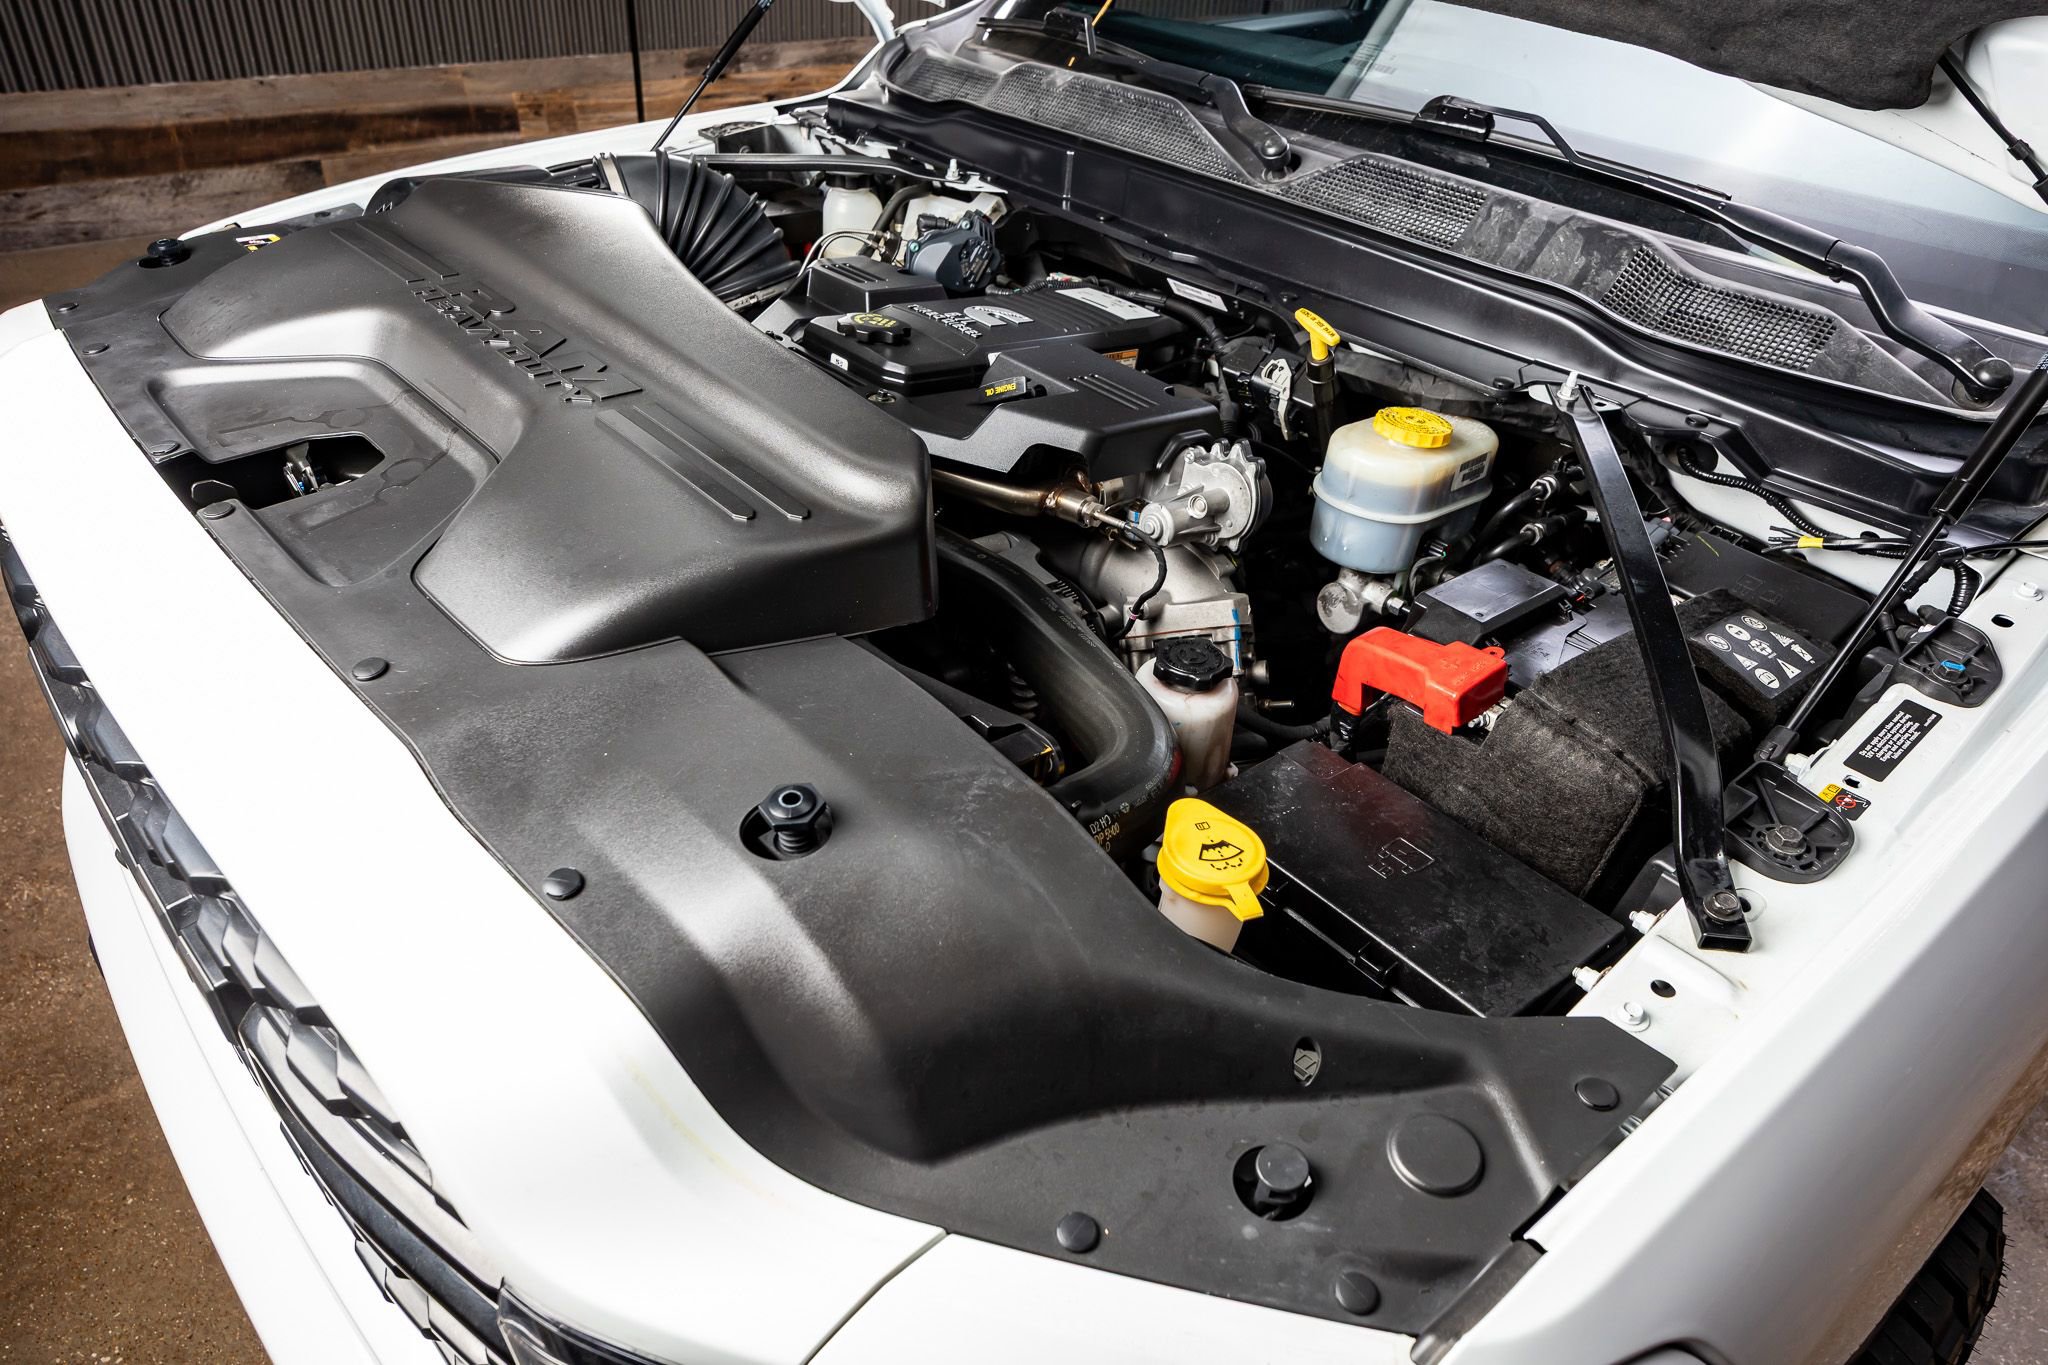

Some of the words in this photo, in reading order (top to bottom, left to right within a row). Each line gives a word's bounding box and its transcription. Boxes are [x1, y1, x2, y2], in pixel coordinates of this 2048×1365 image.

[411, 287, 511, 346] HEAVY
[496, 346, 595, 403] DUTY
[437, 281, 643, 401] RAM
[984, 387, 995, 397] OIL
[995, 382, 1017, 394] ENGINE
